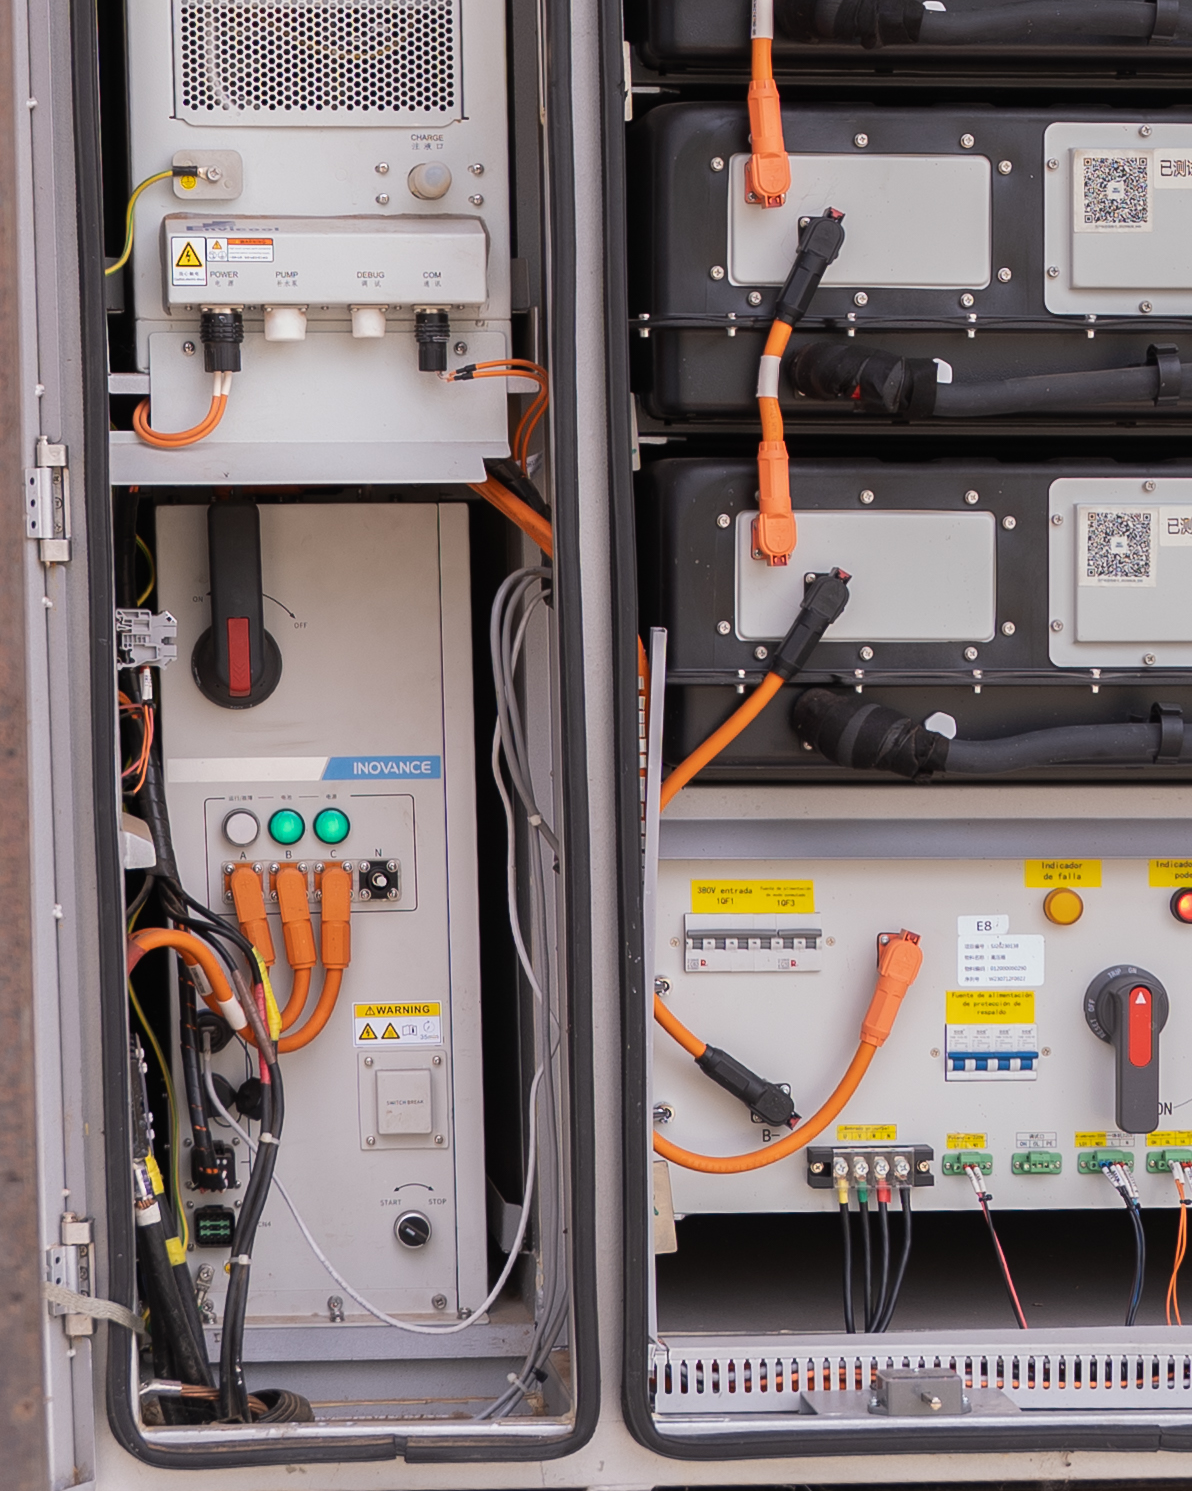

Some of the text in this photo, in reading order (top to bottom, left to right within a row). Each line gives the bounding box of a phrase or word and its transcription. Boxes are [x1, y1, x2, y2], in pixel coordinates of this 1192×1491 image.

[275, 271, 299, 279] PUMP
[356, 271, 385, 279] DEBUG
[353, 761, 432, 774] INOVANCE
[240, 848, 382, 860] A B C N
[976, 921, 992, 931] E8
[974, 1000, 1011, 1008] protección
[376, 1005, 430, 1015] WARNING
[428, 1198, 447, 1206] STOP
